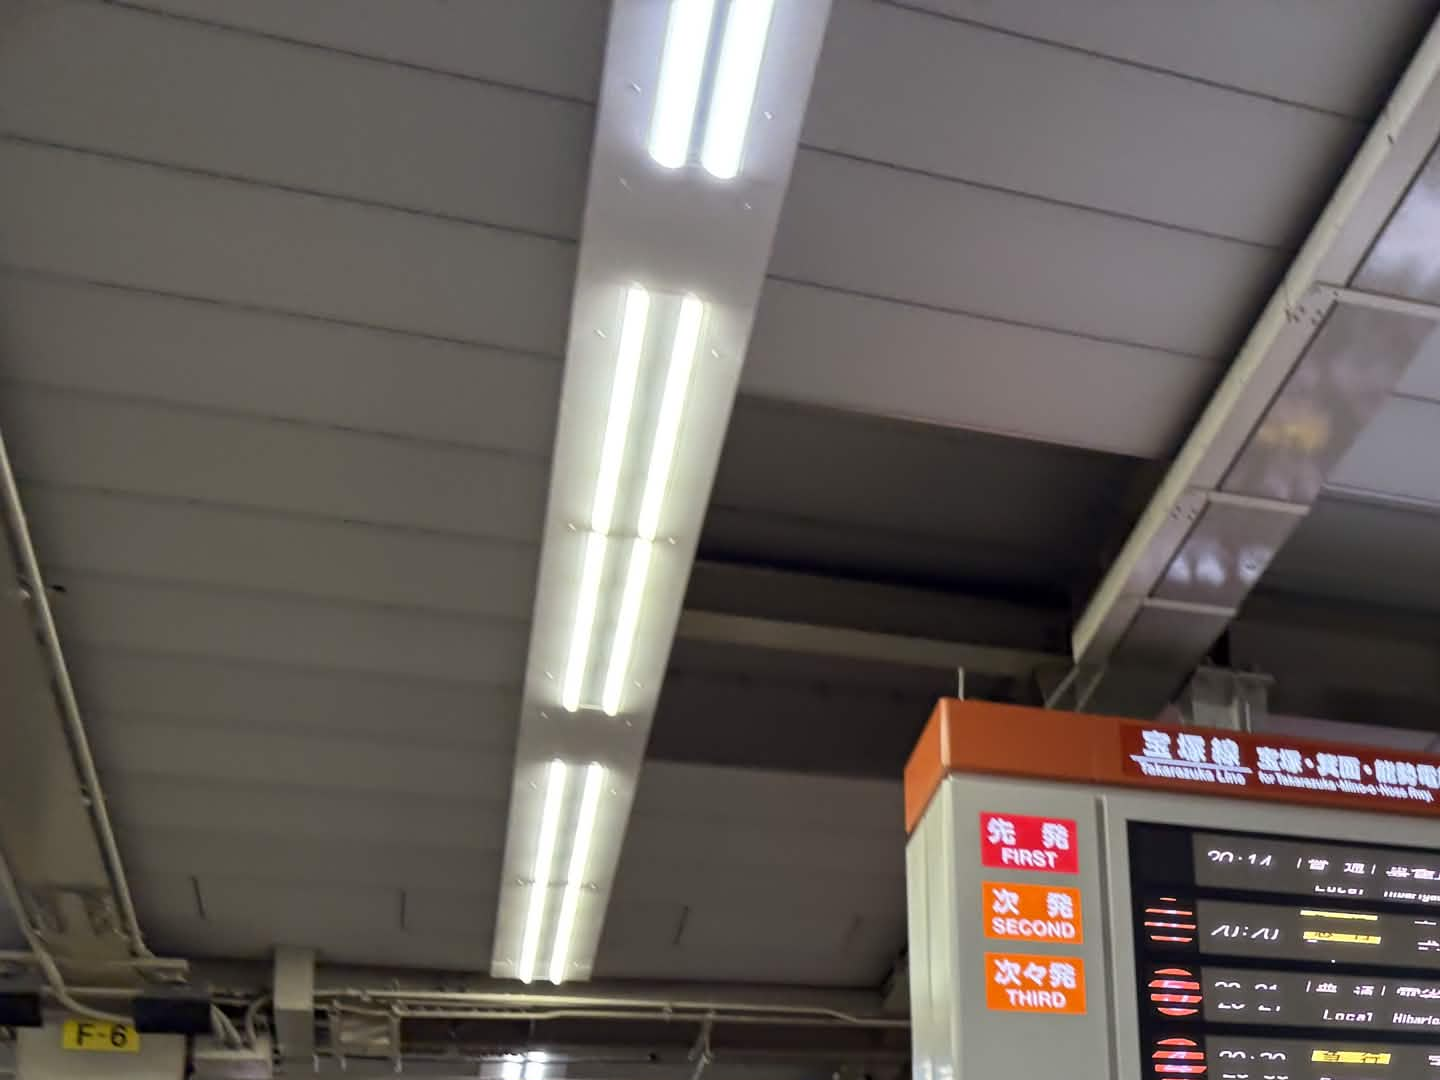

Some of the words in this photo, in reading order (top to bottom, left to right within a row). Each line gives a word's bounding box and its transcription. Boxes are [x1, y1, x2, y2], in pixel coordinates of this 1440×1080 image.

[1001, 847, 1058, 868] FIRST
[992, 917, 1075, 938] SECOND
[994, 959, 1077, 989] 次々発
[1005, 988, 1066, 1009] THIRD
[1323, 1009, 1374, 1023] Local
[76, 1024, 128, 1049] F-6
